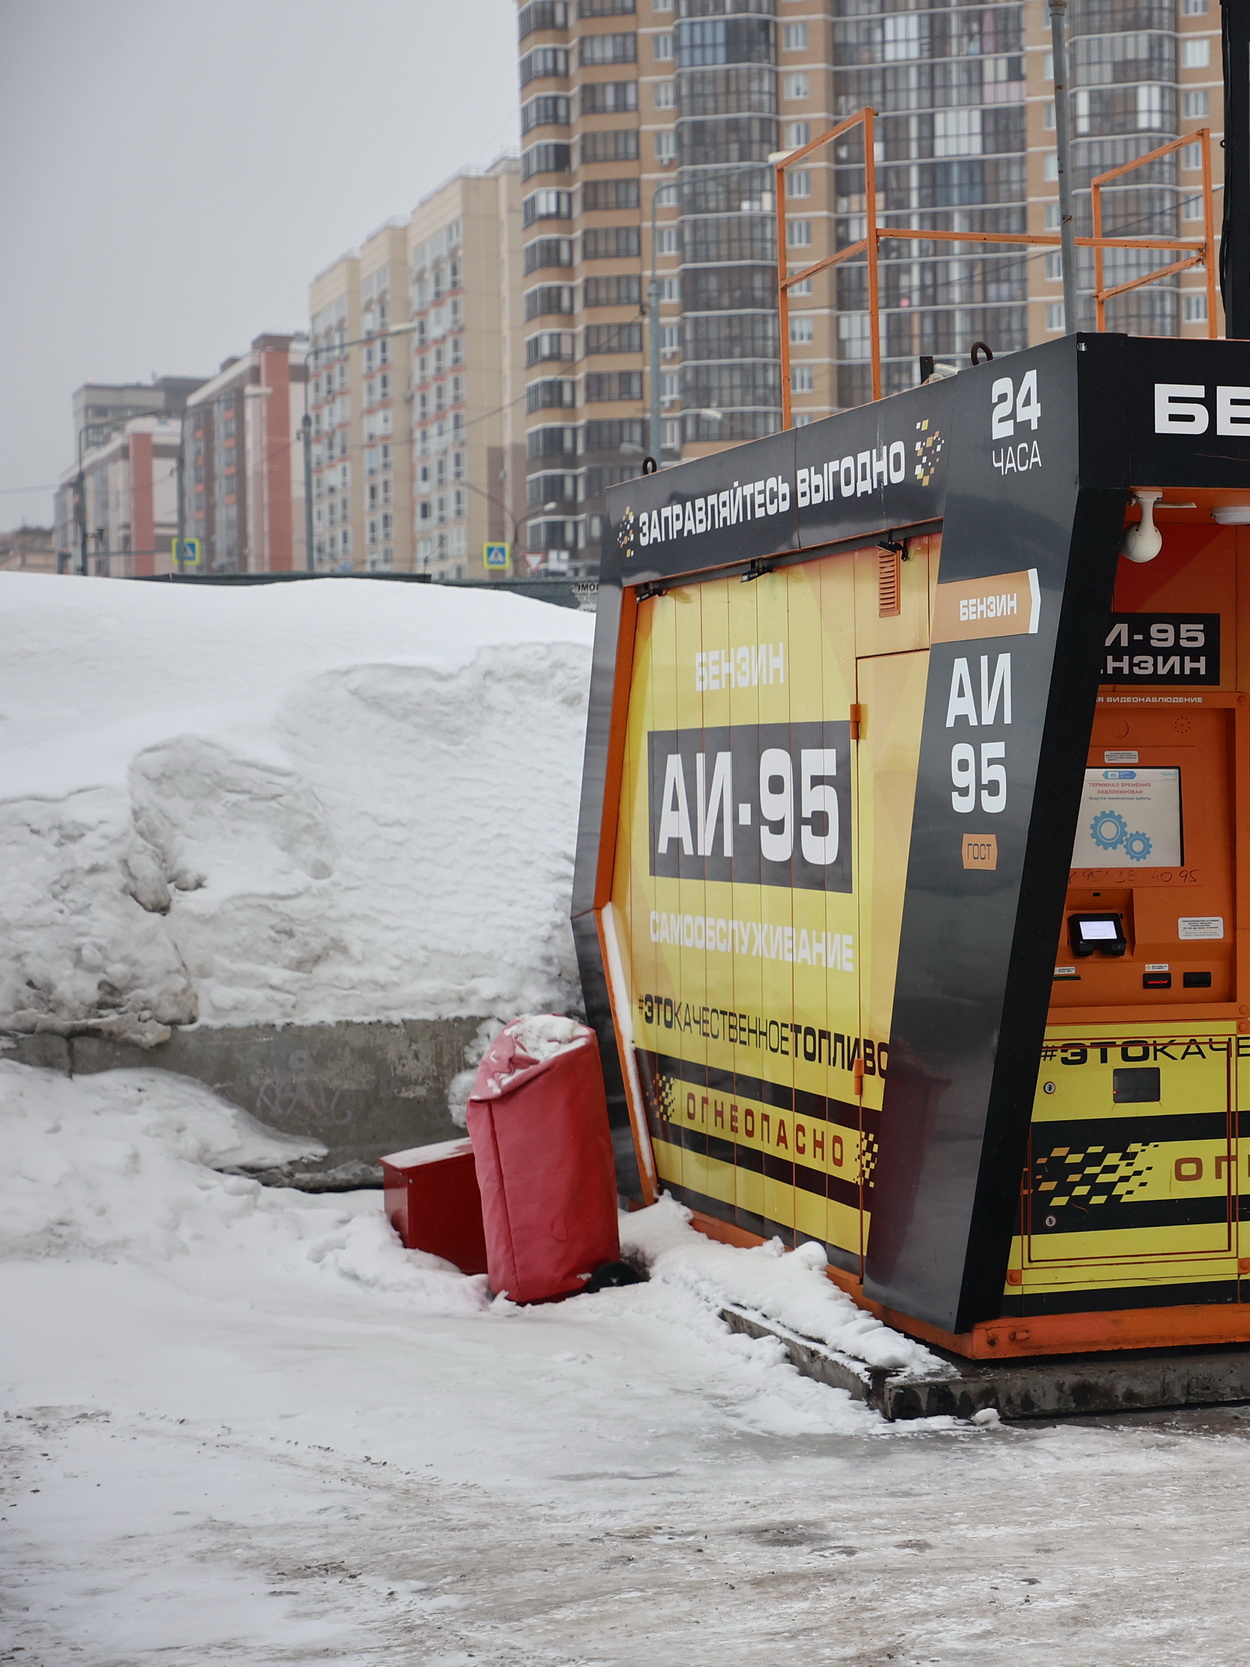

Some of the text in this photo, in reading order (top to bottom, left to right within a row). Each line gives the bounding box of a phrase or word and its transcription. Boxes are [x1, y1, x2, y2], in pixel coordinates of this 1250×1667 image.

[991, 370, 1042, 440] 24
[638, 440, 906, 547] ЗАПРАВЛЯЙТЕСЬ ВЫГОДНО
[991, 441, 1042, 476] ЧАСА
[959, 593, 1018, 621] БЕНЗИН
[694, 642, 784, 692] БЕНЗИН
[946, 653, 1012, 728] АИ
[657, 748, 839, 865] АИ-95
[951, 742, 1007, 814] 95
[966, 842, 992, 862] ГОСТ
[650, 910, 854, 972] САМООБСЛУЖИВАНИЕ
[638, 993, 890, 1079] #ЭТОКАЧЕСТВЕННОЕТОПЛИВО
[686, 1092, 844, 1168] ОГНЕОПАСНО
